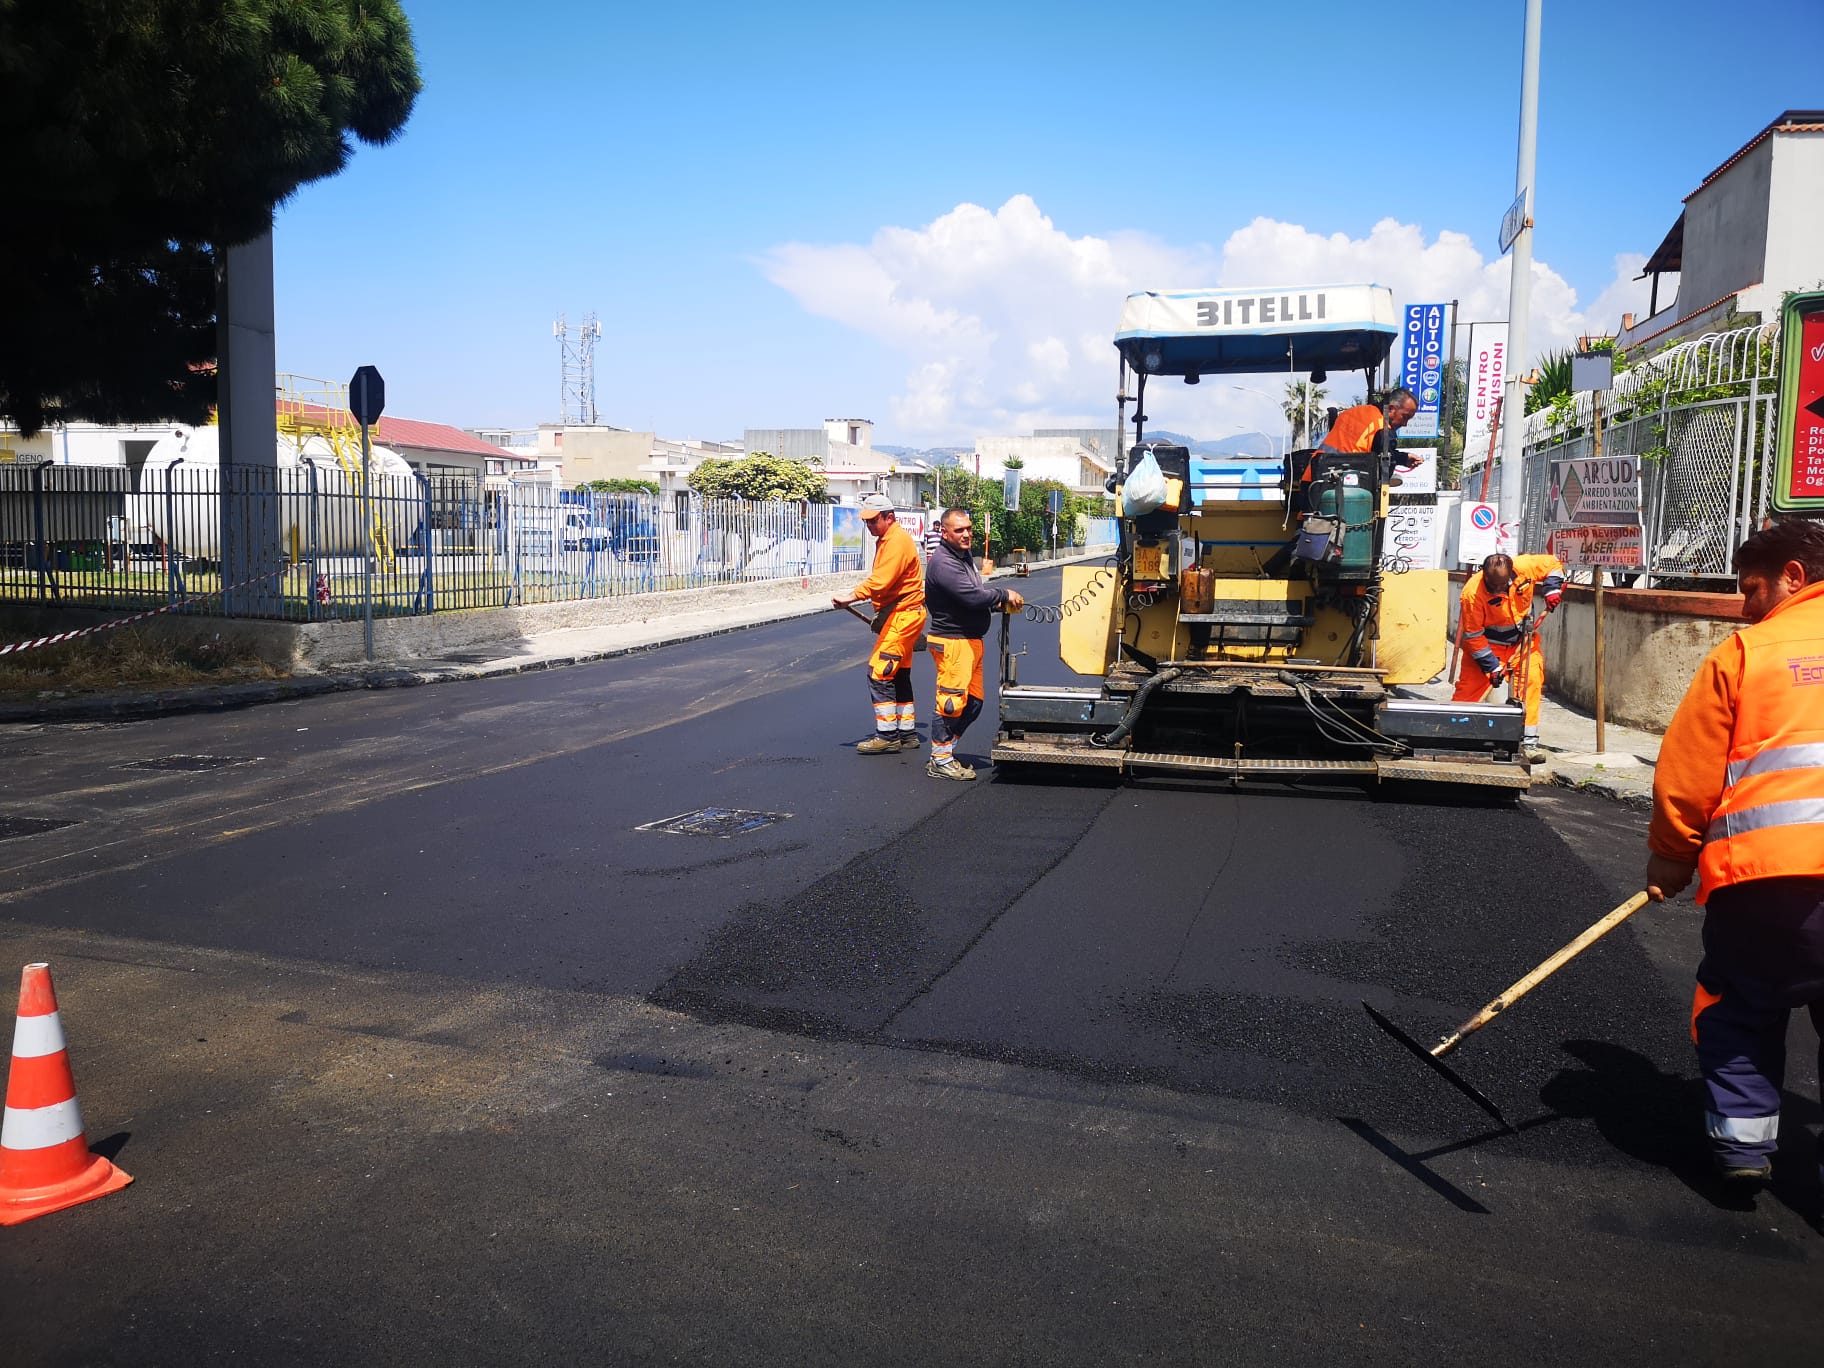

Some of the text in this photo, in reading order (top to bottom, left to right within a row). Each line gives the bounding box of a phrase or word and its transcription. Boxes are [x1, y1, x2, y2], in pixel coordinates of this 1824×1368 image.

[1197, 293, 1326, 327] BITELLI
[1426, 306, 1441, 353] AUTO
[1406, 306, 1421, 392] COLUCC
[1476, 351, 1489, 420] CENTRO
[1809, 427, 1824, 435] Re
[1809, 437, 1824, 446] Di
[1808, 447, 1824, 456] Po
[16, 454, 43, 463] IGENO
[1807, 457, 1824, 466] Ta
[1807, 467, 1824, 475] Mo
[1805, 477, 1824, 486] Og
[1584, 486, 1638, 499] ARREDO BAGNO
[1419, 507, 1434, 515] AUTO
[895, 516, 916, 526] ENTRO
[1555, 526, 1640, 540] CENTRO REVISIONI
